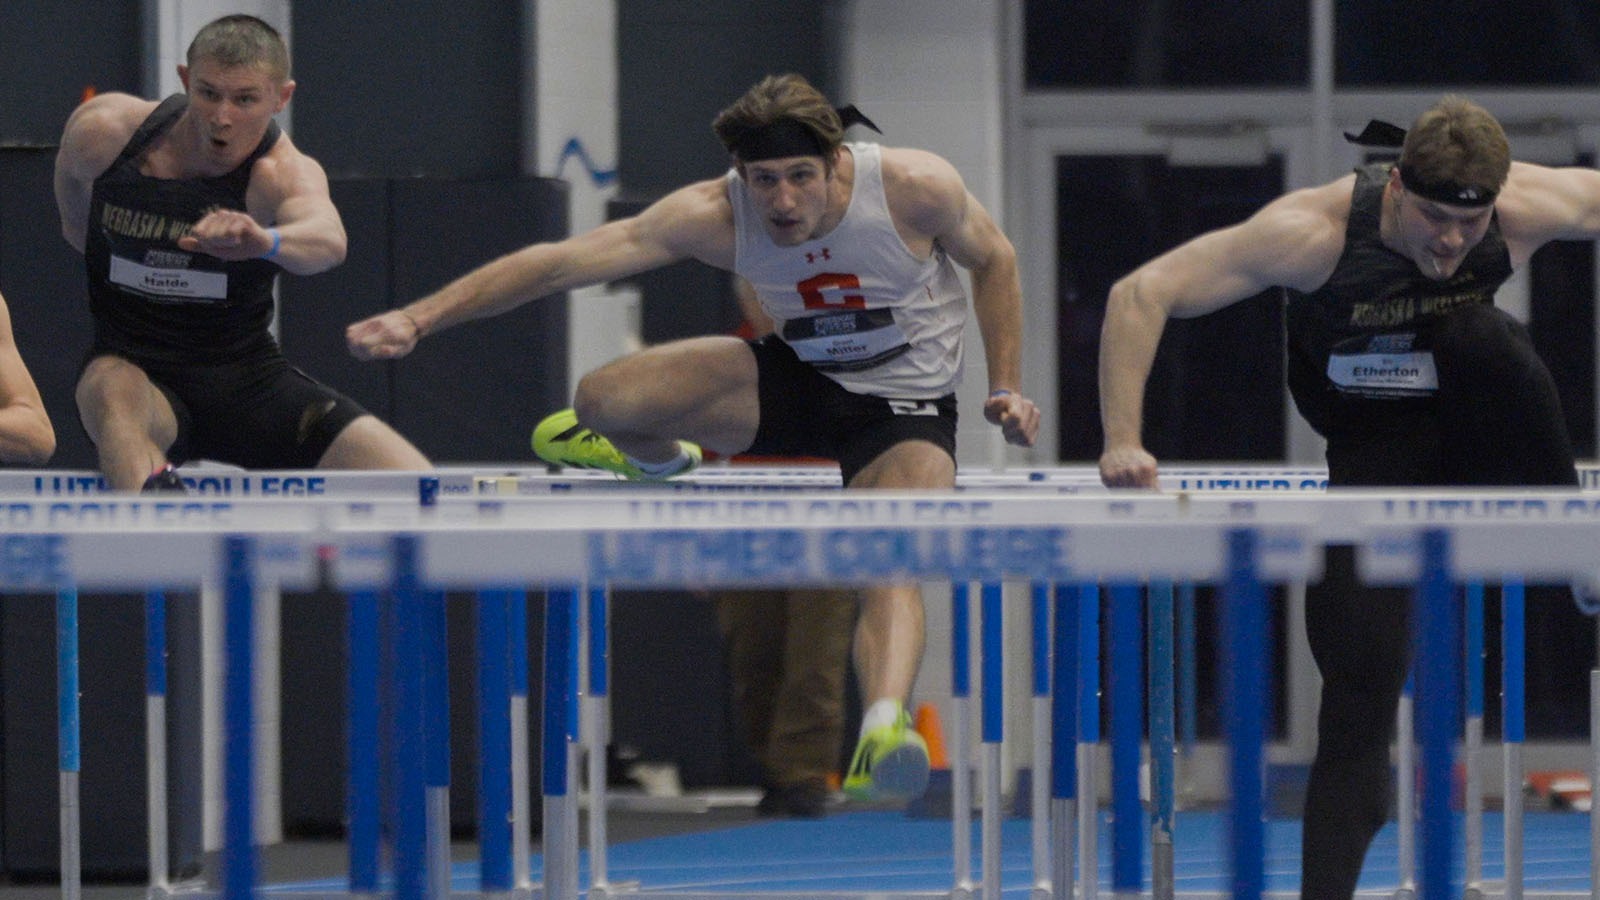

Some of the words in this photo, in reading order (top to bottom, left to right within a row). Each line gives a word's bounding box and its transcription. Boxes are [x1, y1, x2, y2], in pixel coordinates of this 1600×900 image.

[102, 203, 166, 240] NEBRASKA
[144, 276, 189, 288] Halde
[797, 272, 866, 310] C
[826, 345, 867, 357] Miller
[1353, 366, 1419, 377] Etherton
